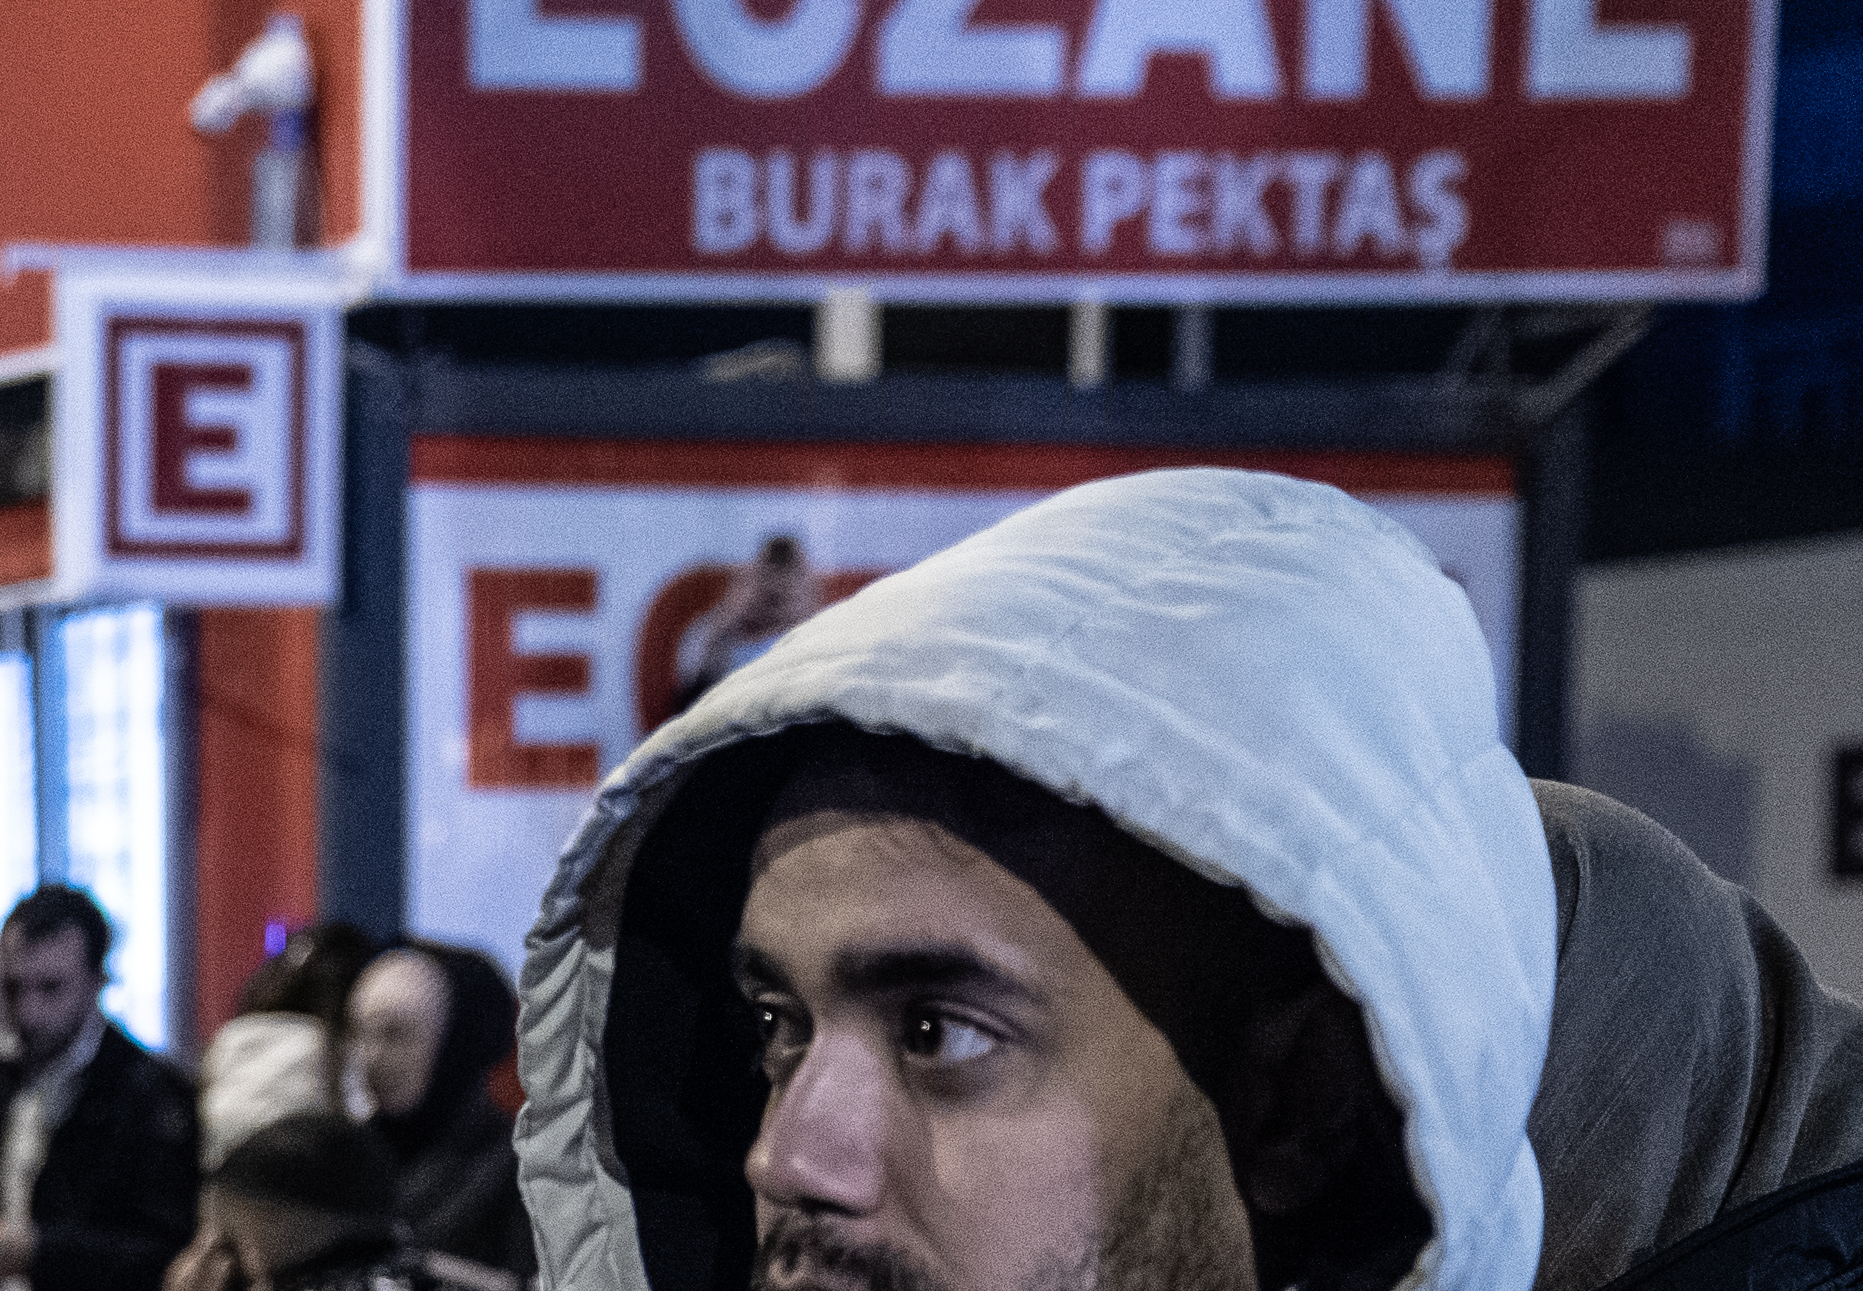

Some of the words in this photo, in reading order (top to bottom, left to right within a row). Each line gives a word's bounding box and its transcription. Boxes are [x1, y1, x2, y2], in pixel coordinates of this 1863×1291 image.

[694, 148, 1059, 254] BURAK
[1081, 148, 1470, 275] PEKTAŞ
[151, 361, 255, 515] E
